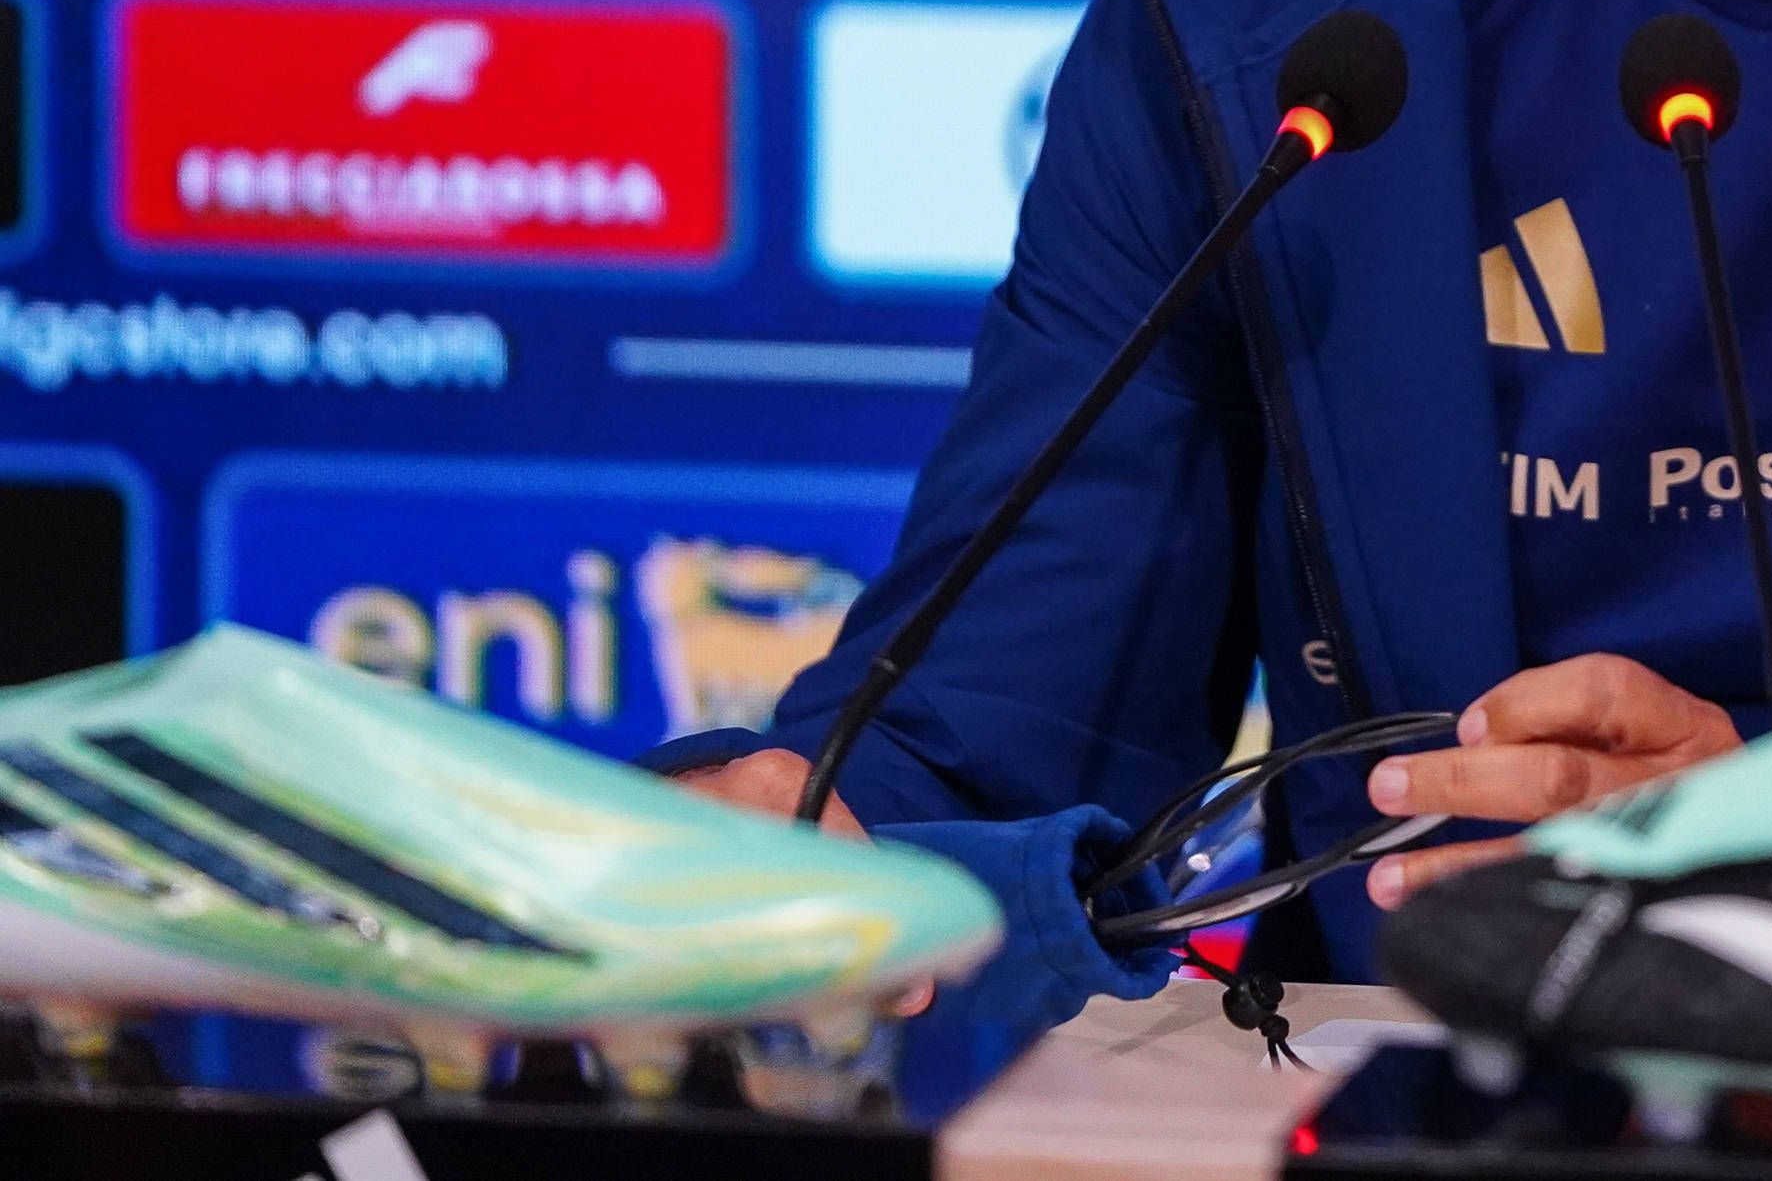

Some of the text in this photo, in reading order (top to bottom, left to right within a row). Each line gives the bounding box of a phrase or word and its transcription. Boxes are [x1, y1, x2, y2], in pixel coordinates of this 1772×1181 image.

[0, 289, 507, 391] igcstore.com
[1501, 451, 1599, 520] IM
[312, 550, 618, 722] eni
